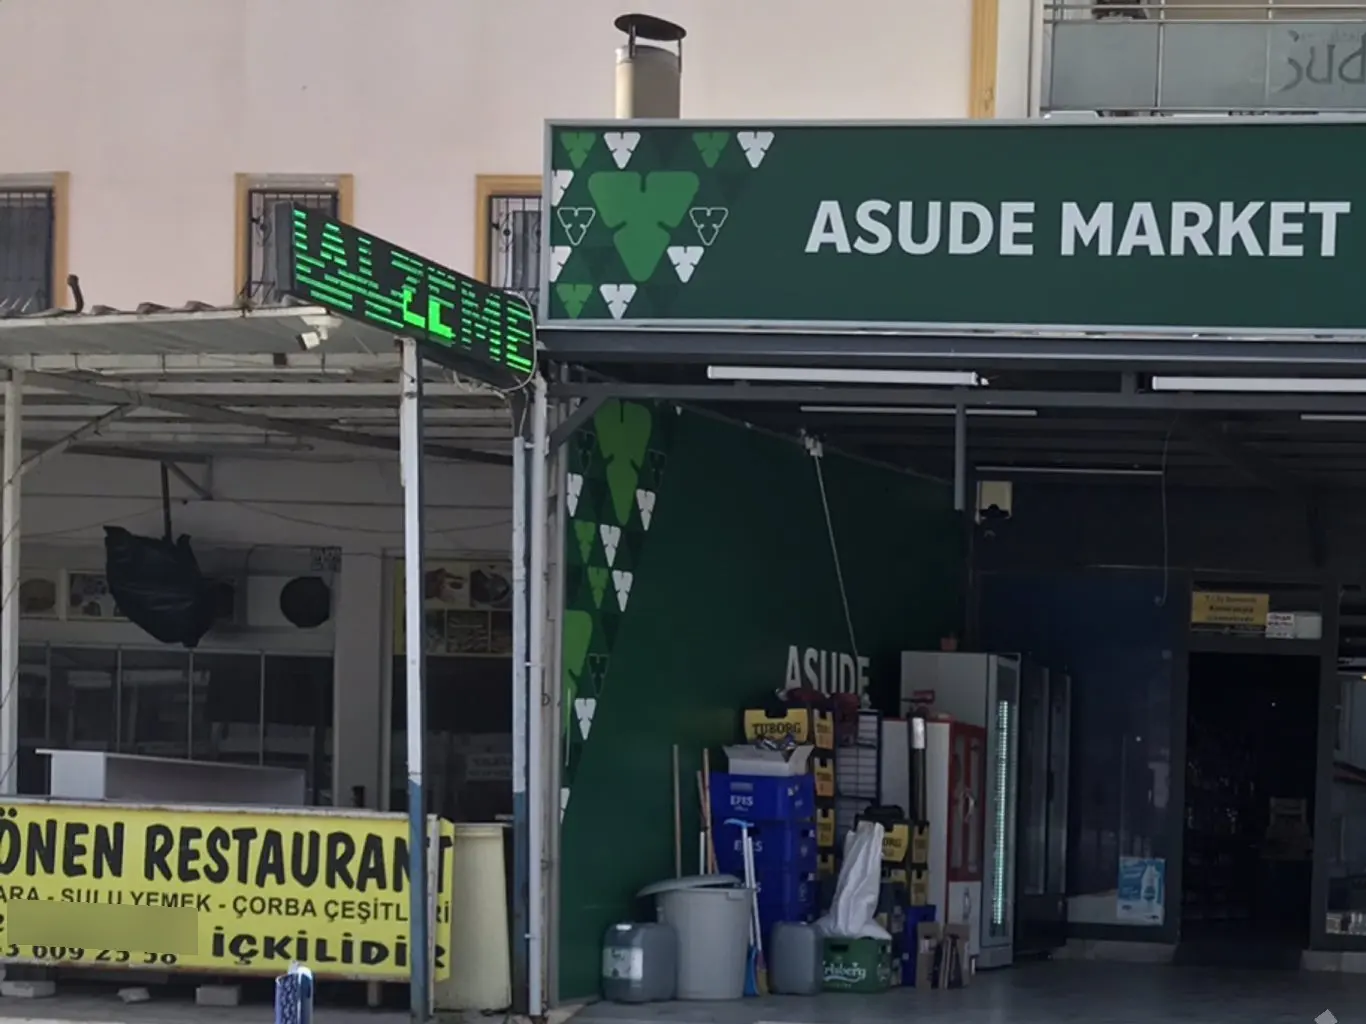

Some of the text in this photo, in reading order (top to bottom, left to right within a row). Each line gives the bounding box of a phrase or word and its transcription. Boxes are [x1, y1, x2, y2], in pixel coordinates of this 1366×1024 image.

[804, 199, 1351, 257] ASUDE MARKET
[784, 645, 871, 706] ASUDE
[752, 721, 802, 736] TUBORG
[233, 895, 318, 919] ÇORBA
[324, 897, 449, 925] ÇEŞİTLİ
[823, 961, 867, 980] rlsberg
